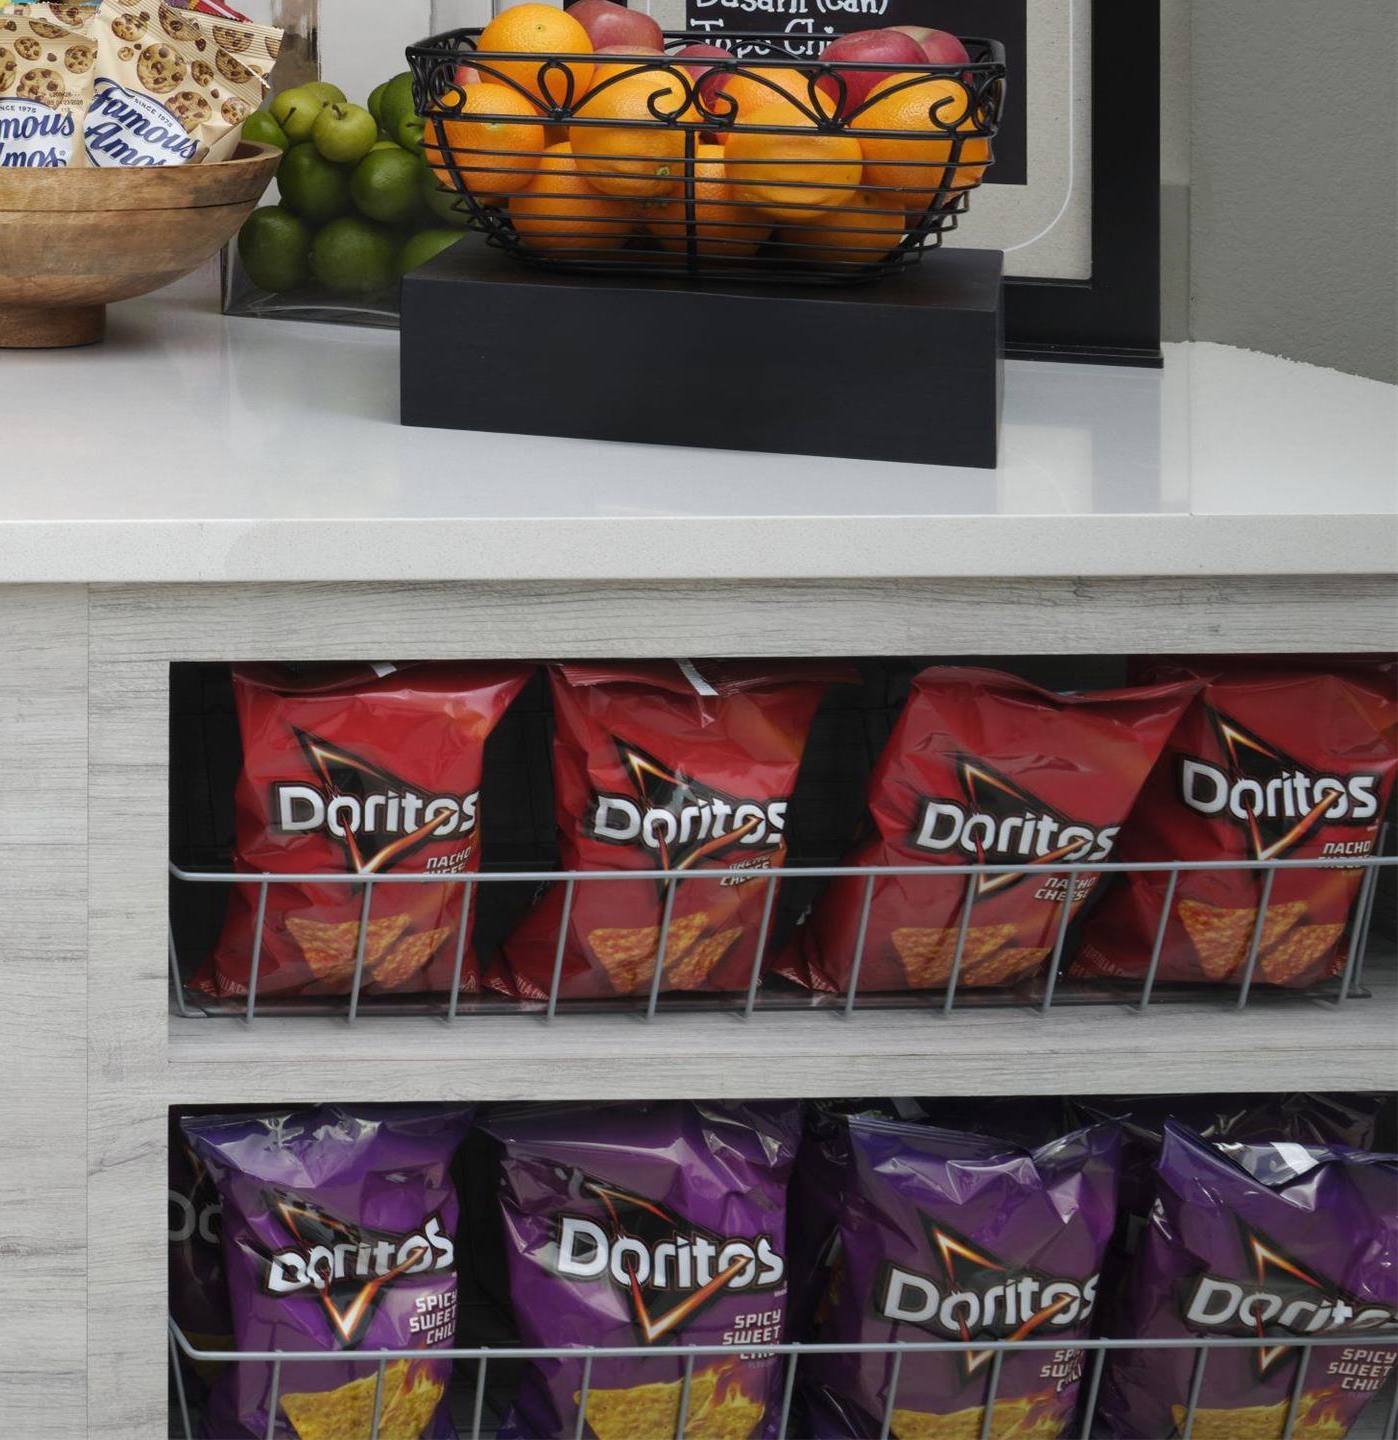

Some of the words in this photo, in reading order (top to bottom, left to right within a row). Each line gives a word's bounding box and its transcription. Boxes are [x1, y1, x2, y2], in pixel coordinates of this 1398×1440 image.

[17, 105, 38, 114] 1975
[132, 96, 158, 117] SINCE
[157, 112, 174, 129] 1975
[1181, 758, 1379, 820] Doritos
[276, 784, 481, 840] Doritos
[593, 791, 789, 851] Doritos
[914, 800, 1122, 862] Doritos
[1321, 839, 1372, 856] NACHO
[264, 1214, 456, 1293] Doritos
[555, 1215, 786, 1293] Doritos
[414, 1289, 458, 1315] SPICY
[881, 1263, 1102, 1334] Doritos
[407, 1306, 459, 1335] SWEET
[733, 1308, 781, 1330] SPICY
[721, 1324, 781, 1347] SWEET
[1327, 1361, 1395, 1379] SWEET
[1340, 1347, 1397, 1365] SPICY
